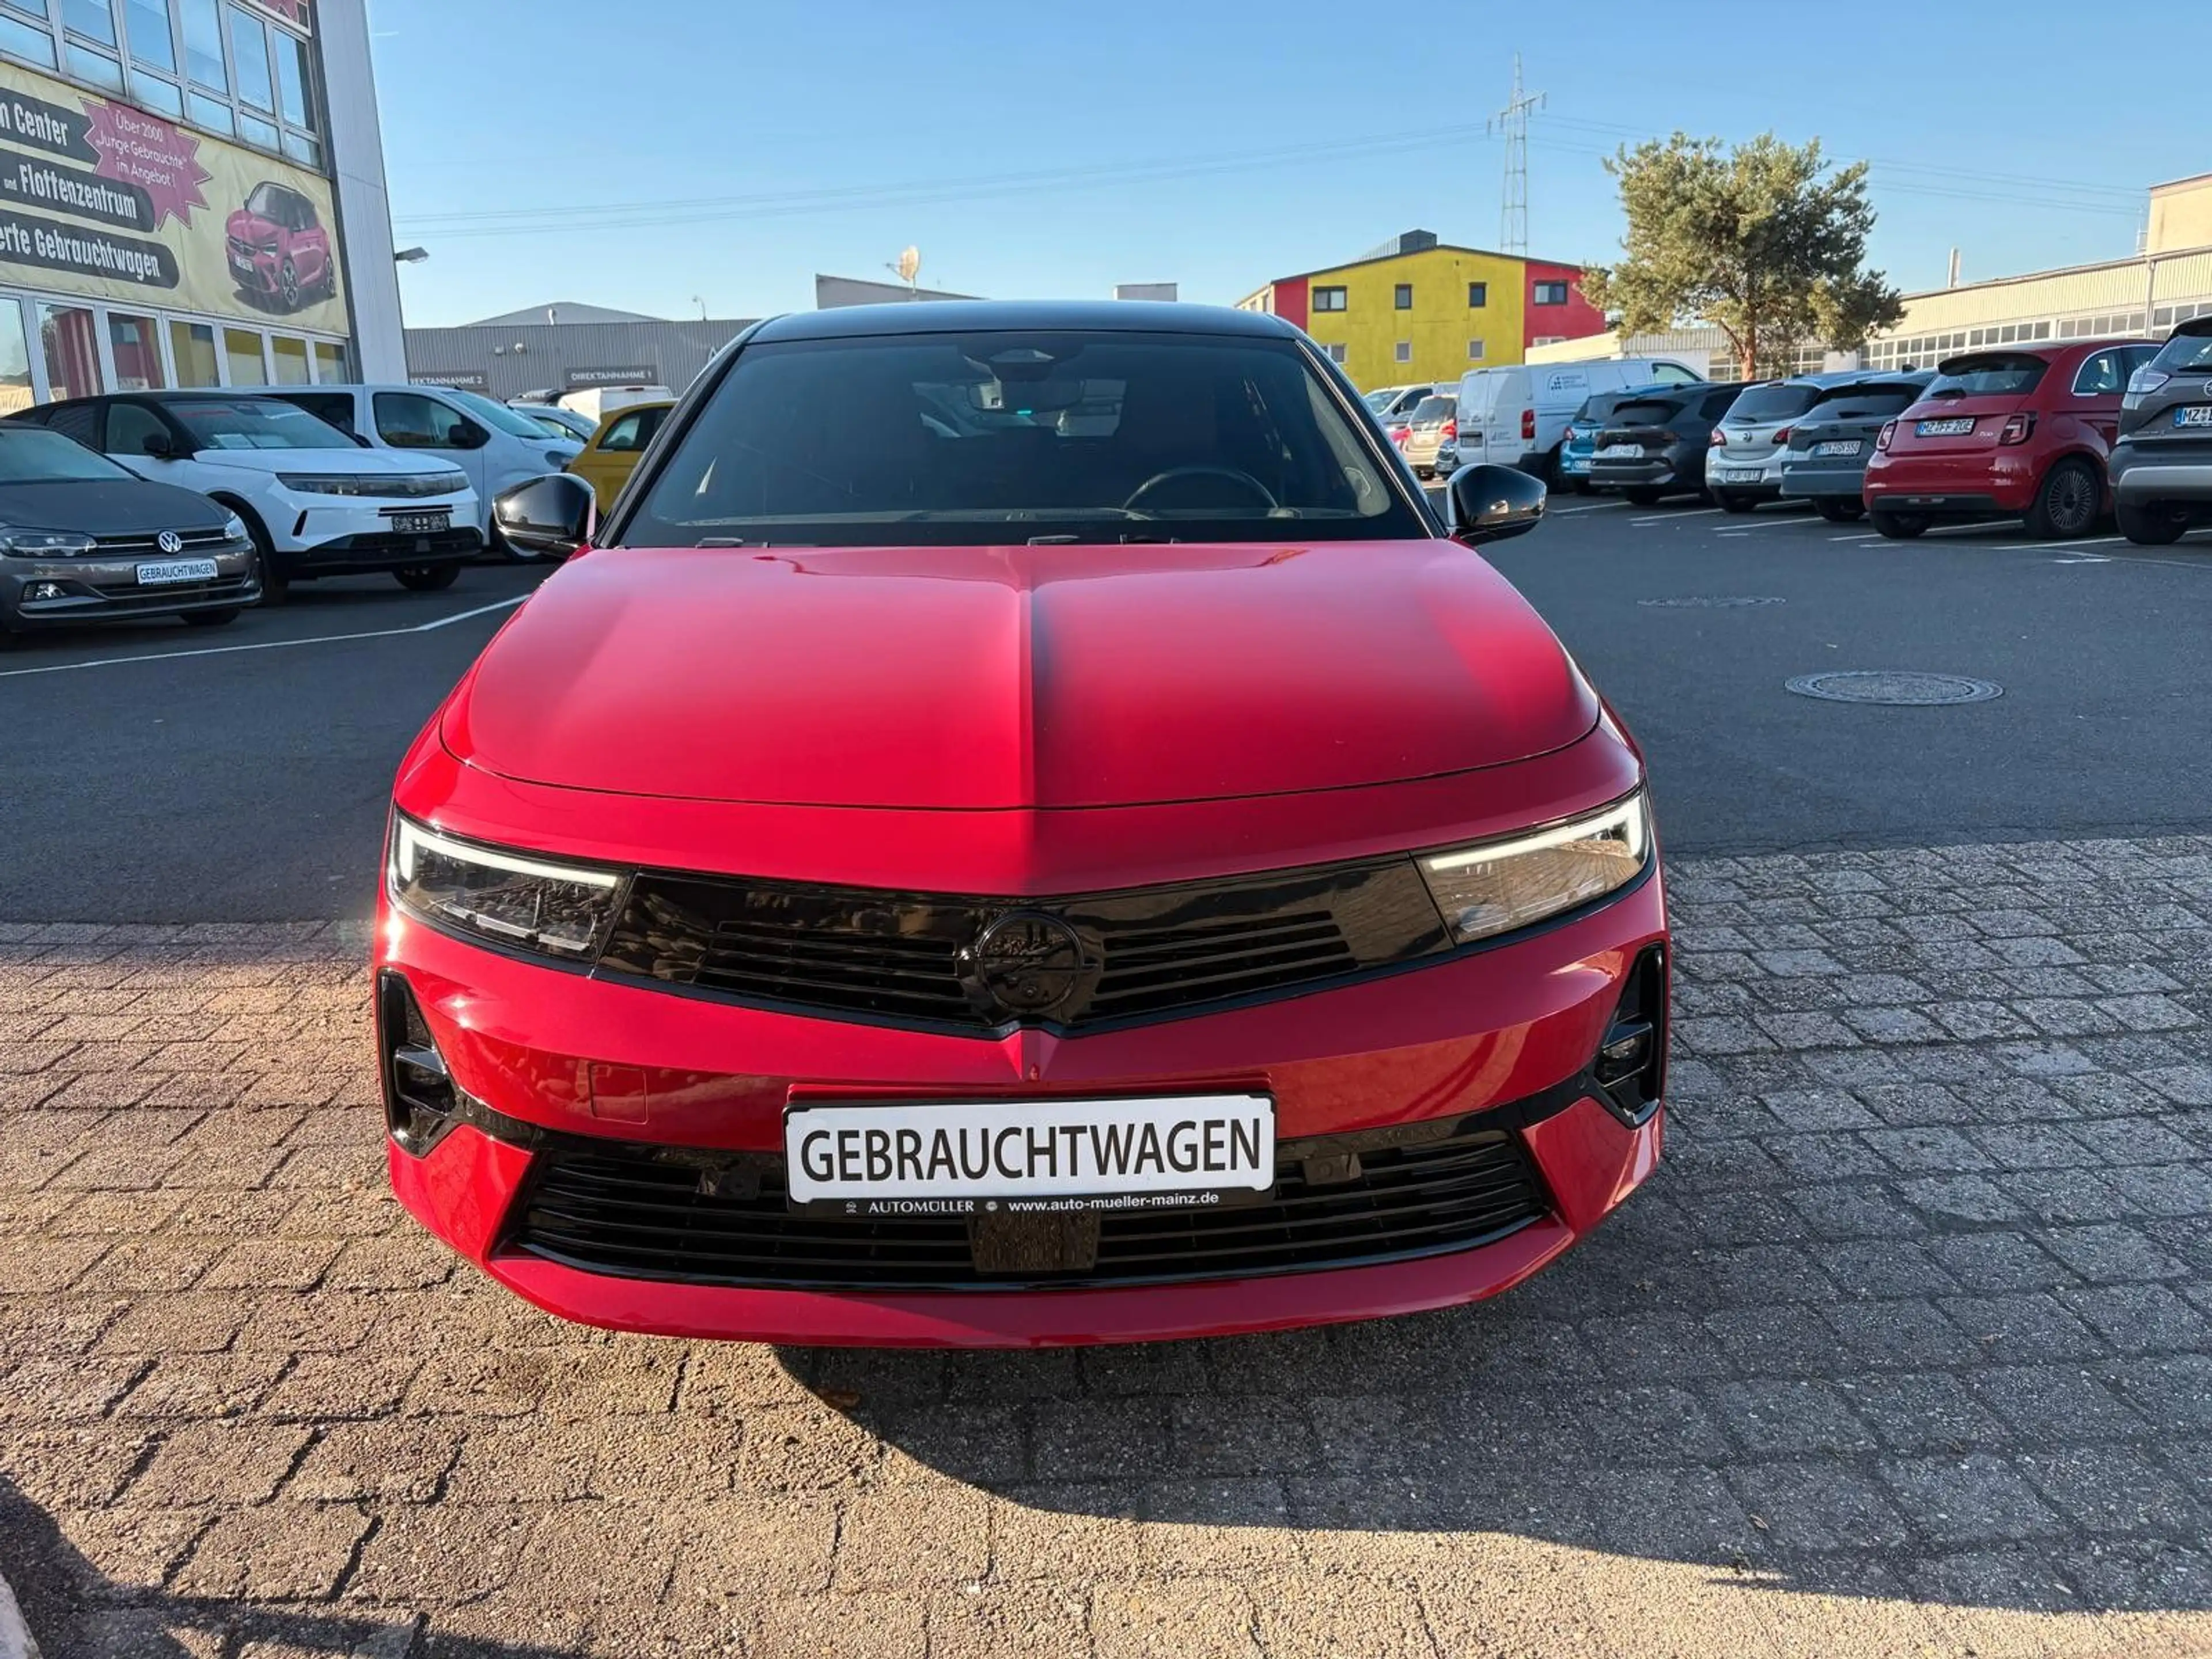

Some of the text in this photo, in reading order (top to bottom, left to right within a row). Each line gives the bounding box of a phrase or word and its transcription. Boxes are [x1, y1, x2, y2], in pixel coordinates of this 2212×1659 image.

[14, 103, 68, 146] Center
[116, 109, 140, 134] Über
[116, 157, 130, 175] im
[20, 164, 137, 219] Flottenzentrum
[34, 229, 160, 281] Gebrauchtwagen
[139, 562, 215, 579] GEBRAUCHTWAGEN
[801, 1118, 1260, 1182] GEBRAUCHTWAGEN
[868, 1192, 1219, 1214] AUTOMÜLLER www.auto-mueller-mainz.de
